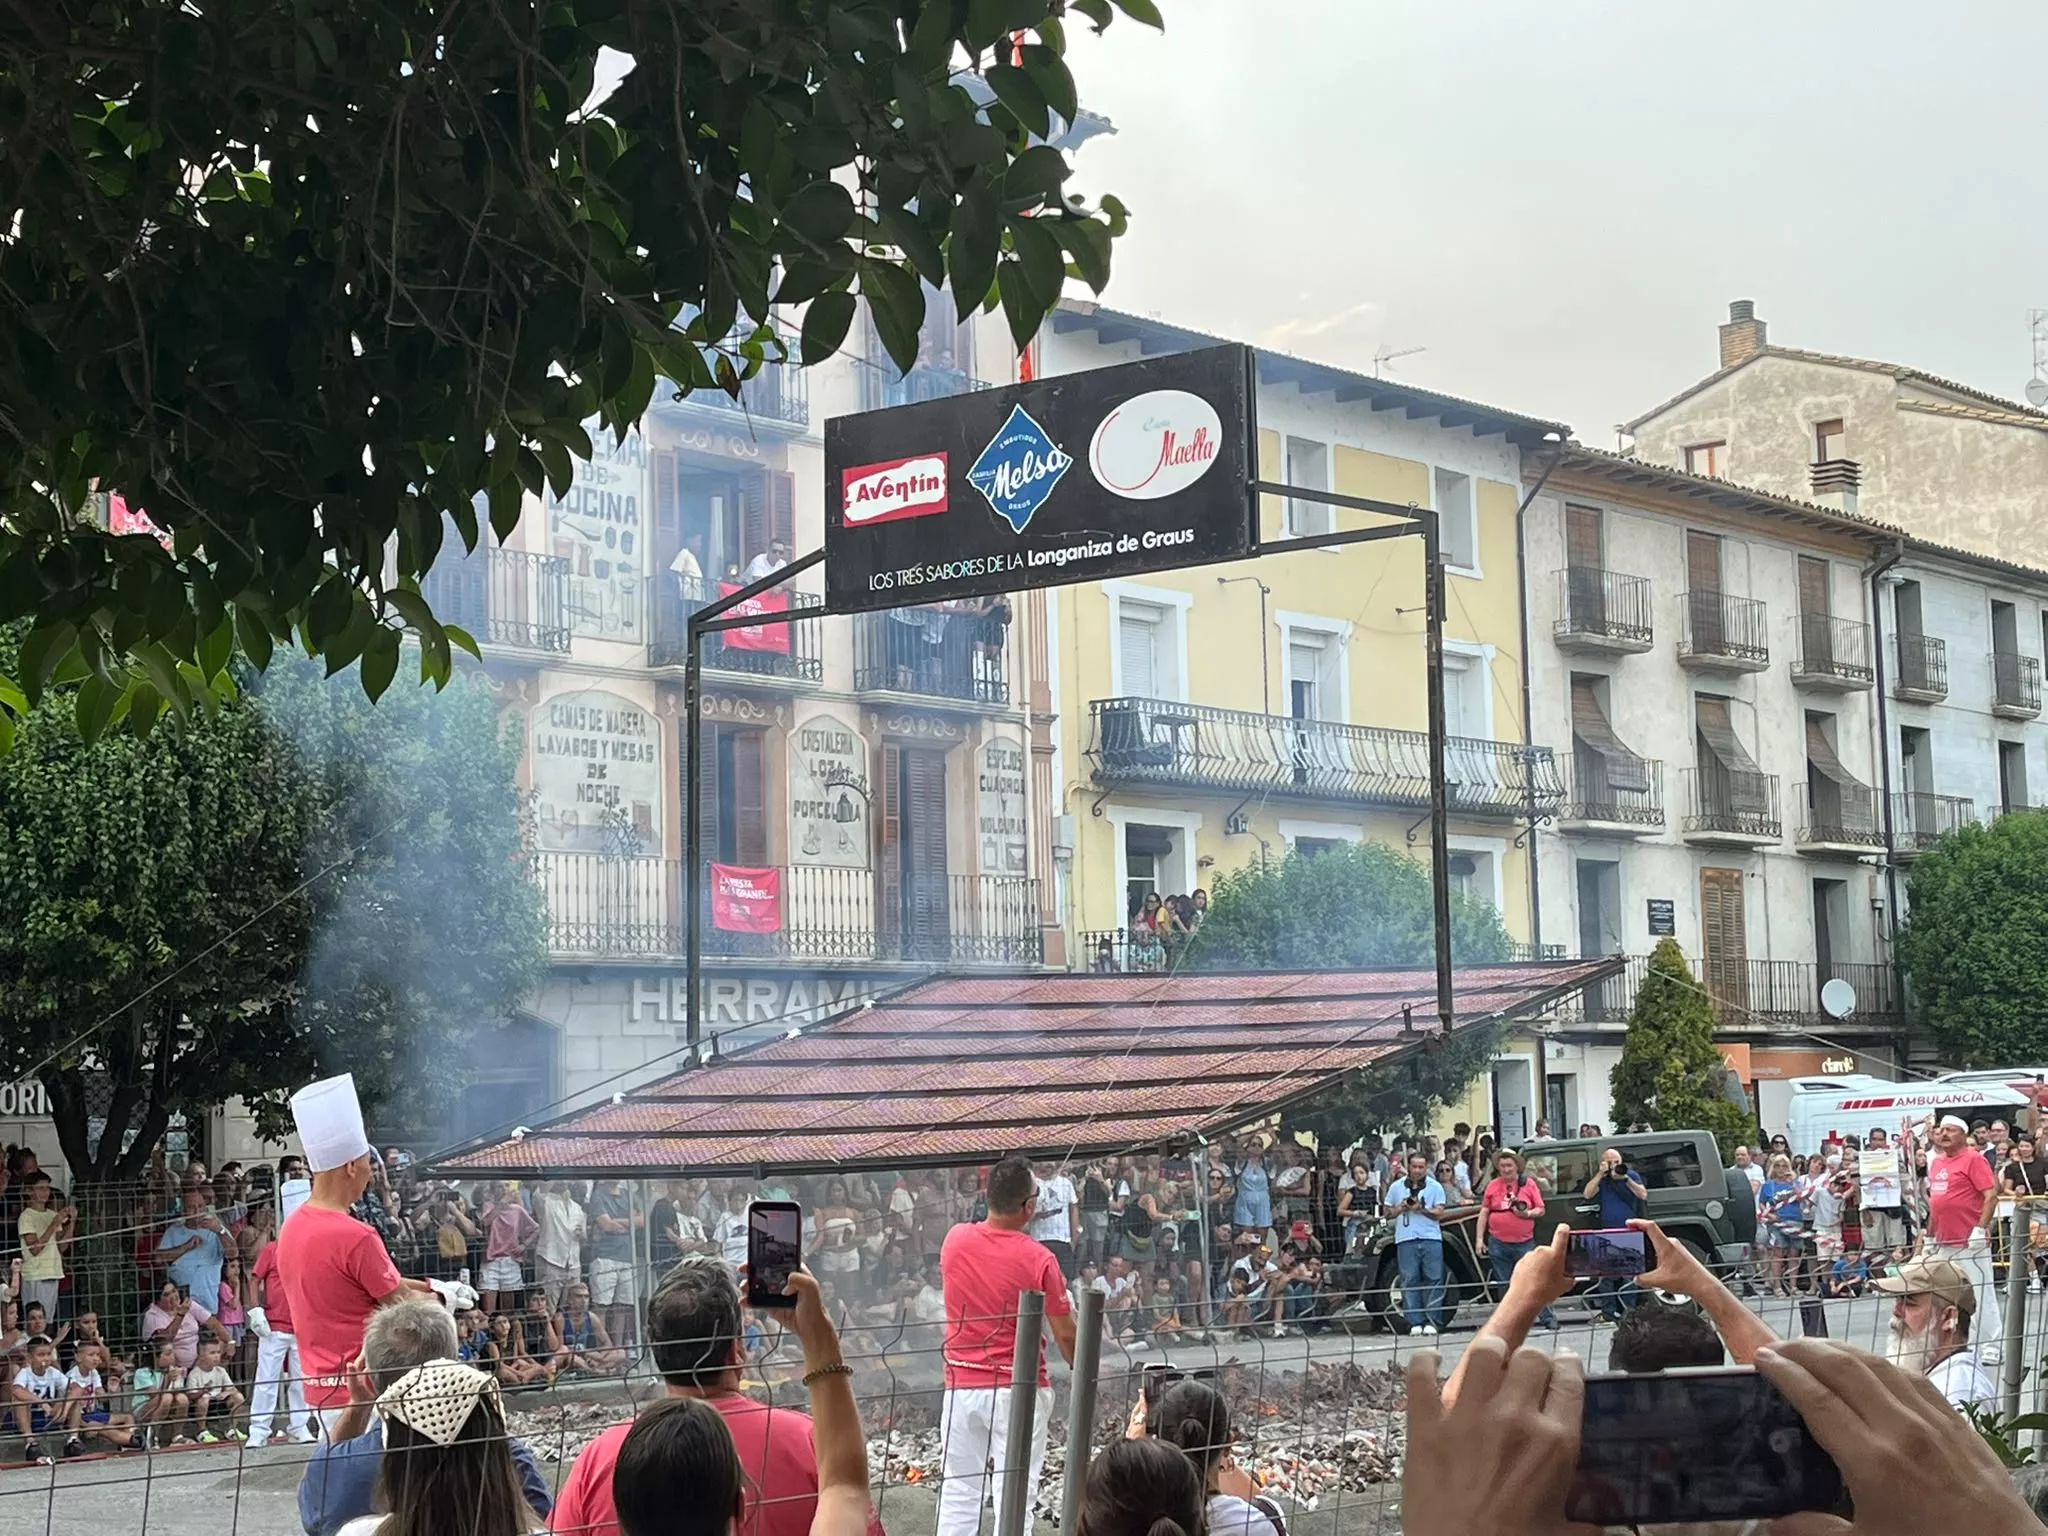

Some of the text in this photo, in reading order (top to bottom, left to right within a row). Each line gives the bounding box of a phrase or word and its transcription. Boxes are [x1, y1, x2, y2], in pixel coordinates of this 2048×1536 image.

[1164, 427, 1213, 466] Maella
[581, 463, 608, 485] DE
[856, 473, 939, 502] Aventín
[984, 449, 1065, 501] Melsa
[869, 571, 894, 591] LOS
[926, 557, 984, 582] SABORES
[987, 555, 1004, 573] DE
[1007, 552, 1024, 570] LA
[1028, 540, 1112, 566] Longaniza
[1116, 534, 1139, 553] de
[1142, 529, 1195, 549] Graus
[551, 704, 646, 737] CAMAS DE MADERA
[538, 734, 654, 763] LAVABOS Y MESAS
[576, 784, 620, 805] NOCHE
[793, 799, 861, 822] PORCELA
[0, 1085, 54, 1115] ORI
[1896, 1093, 1984, 1107] AMBULANCIA
